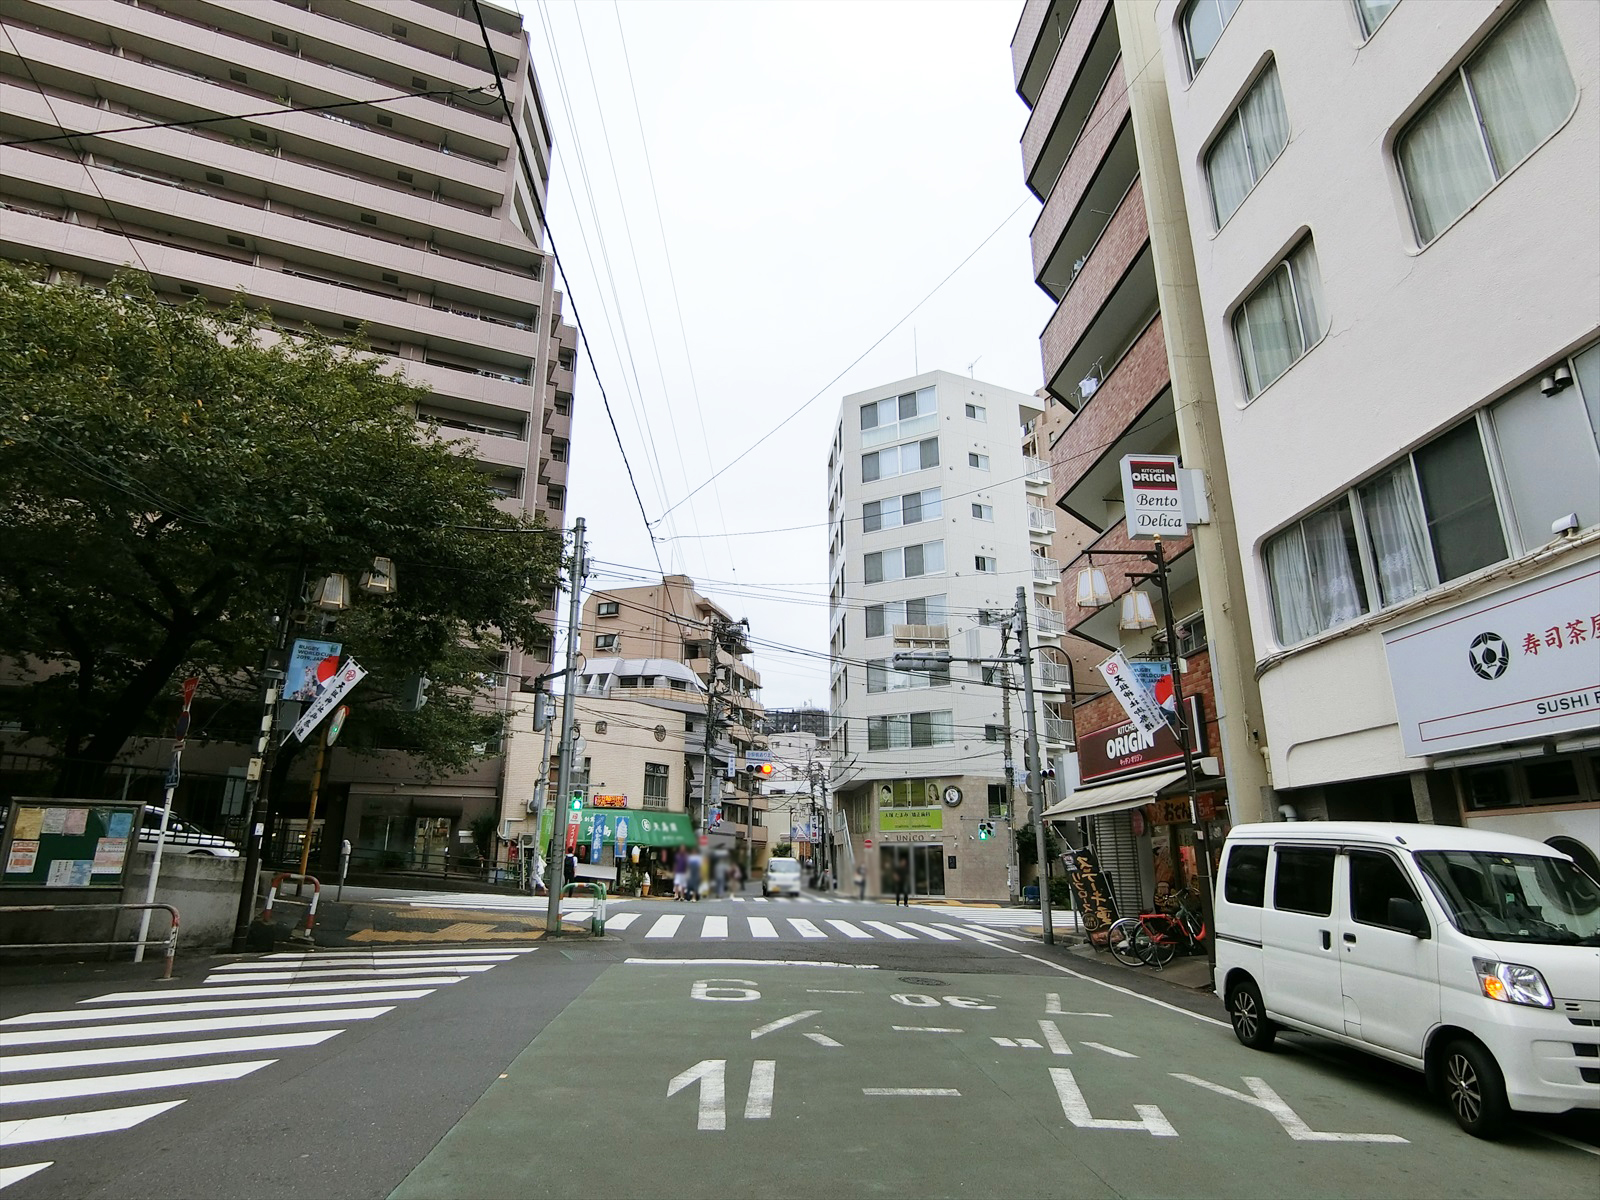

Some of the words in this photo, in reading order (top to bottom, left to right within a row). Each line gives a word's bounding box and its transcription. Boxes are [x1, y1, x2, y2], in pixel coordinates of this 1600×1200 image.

[1132, 473, 1176, 483] ORIGIN
[1136, 493, 1178, 507] Bento
[1137, 512, 1183, 528] Delica
[1536, 694, 1590, 715] SUSHI
[1117, 723, 1137, 736] KITCHE
[1106, 731, 1155, 760] ORIGIN
